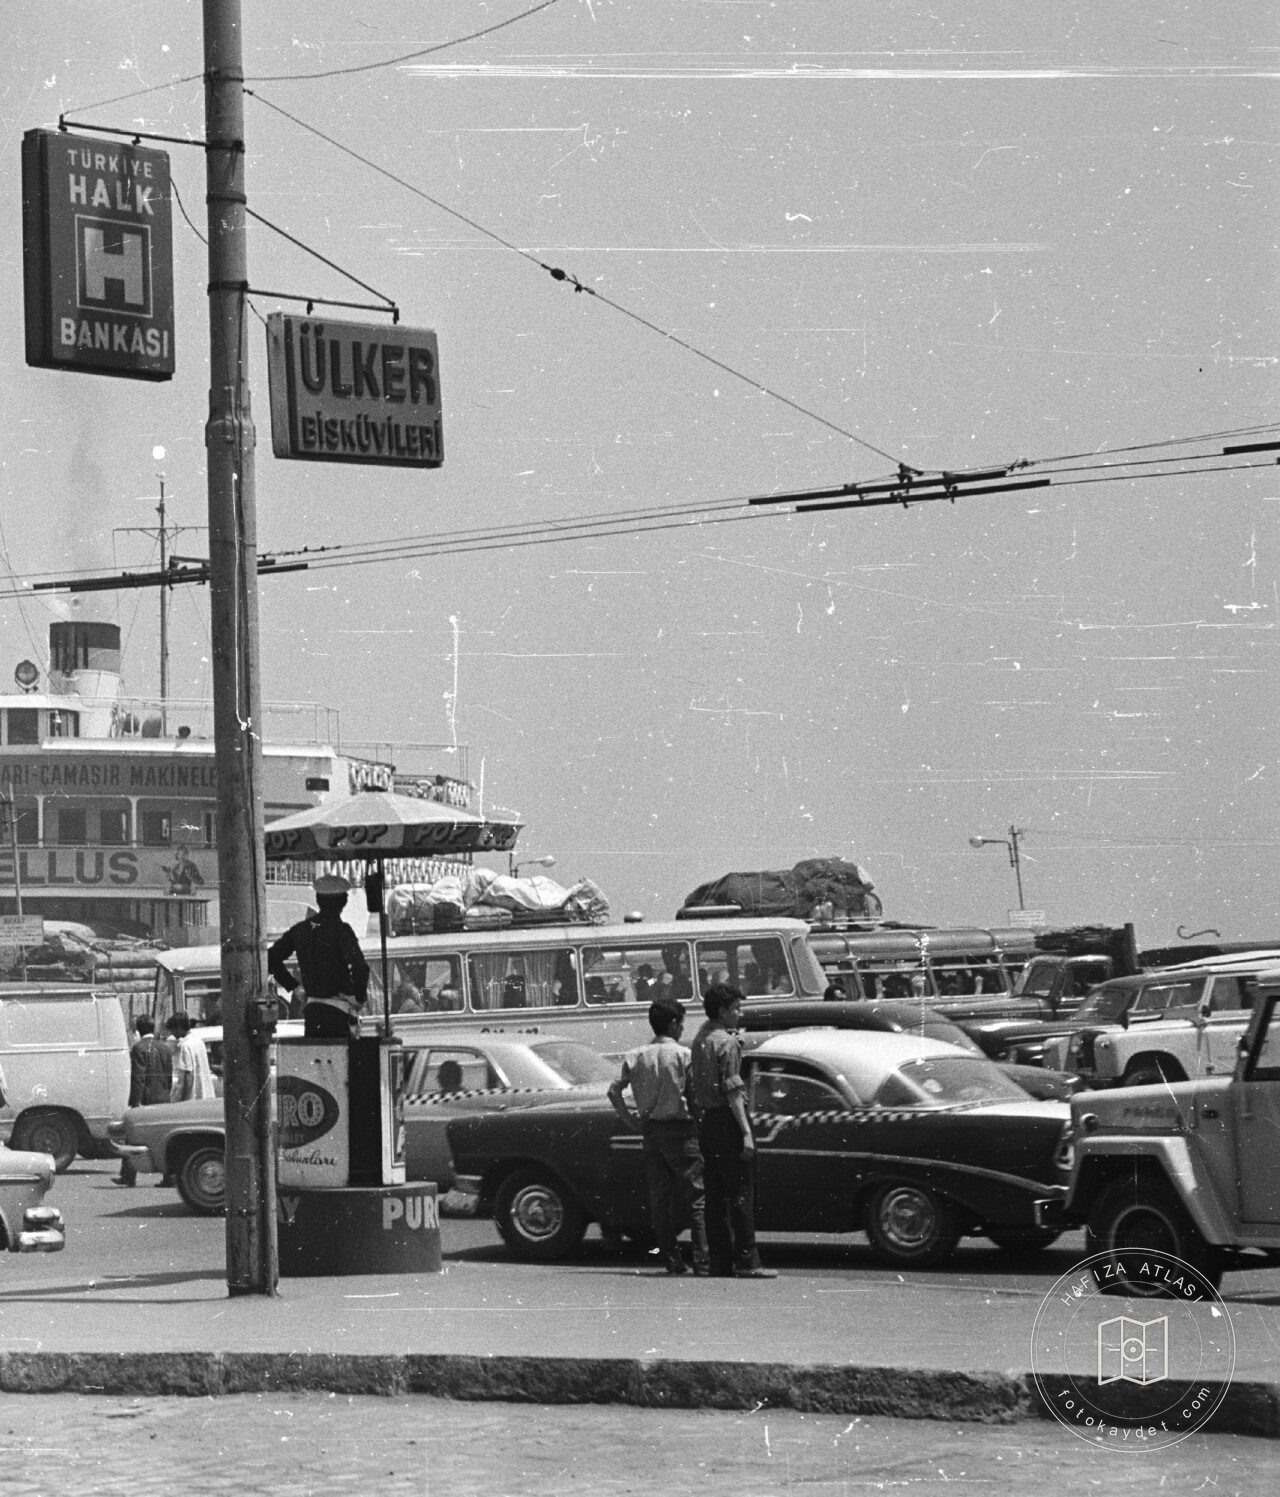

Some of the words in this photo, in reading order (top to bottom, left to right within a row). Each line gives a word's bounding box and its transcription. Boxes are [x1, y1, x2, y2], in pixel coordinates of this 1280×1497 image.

[66, 148, 154, 179] TÜRKİYE
[68, 172, 155, 216] HALK
[83, 226, 145, 306] H
[59, 316, 169, 359] BANKASI
[299, 322, 438, 406] ÜLKER
[301, 410, 441, 459] BİSKÜVİLERİ
[129, 762, 217, 787] MAKİNELE
[266, 830, 301, 849] OP
[328, 824, 389, 847] POP
[414, 823, 468, 846] POP
